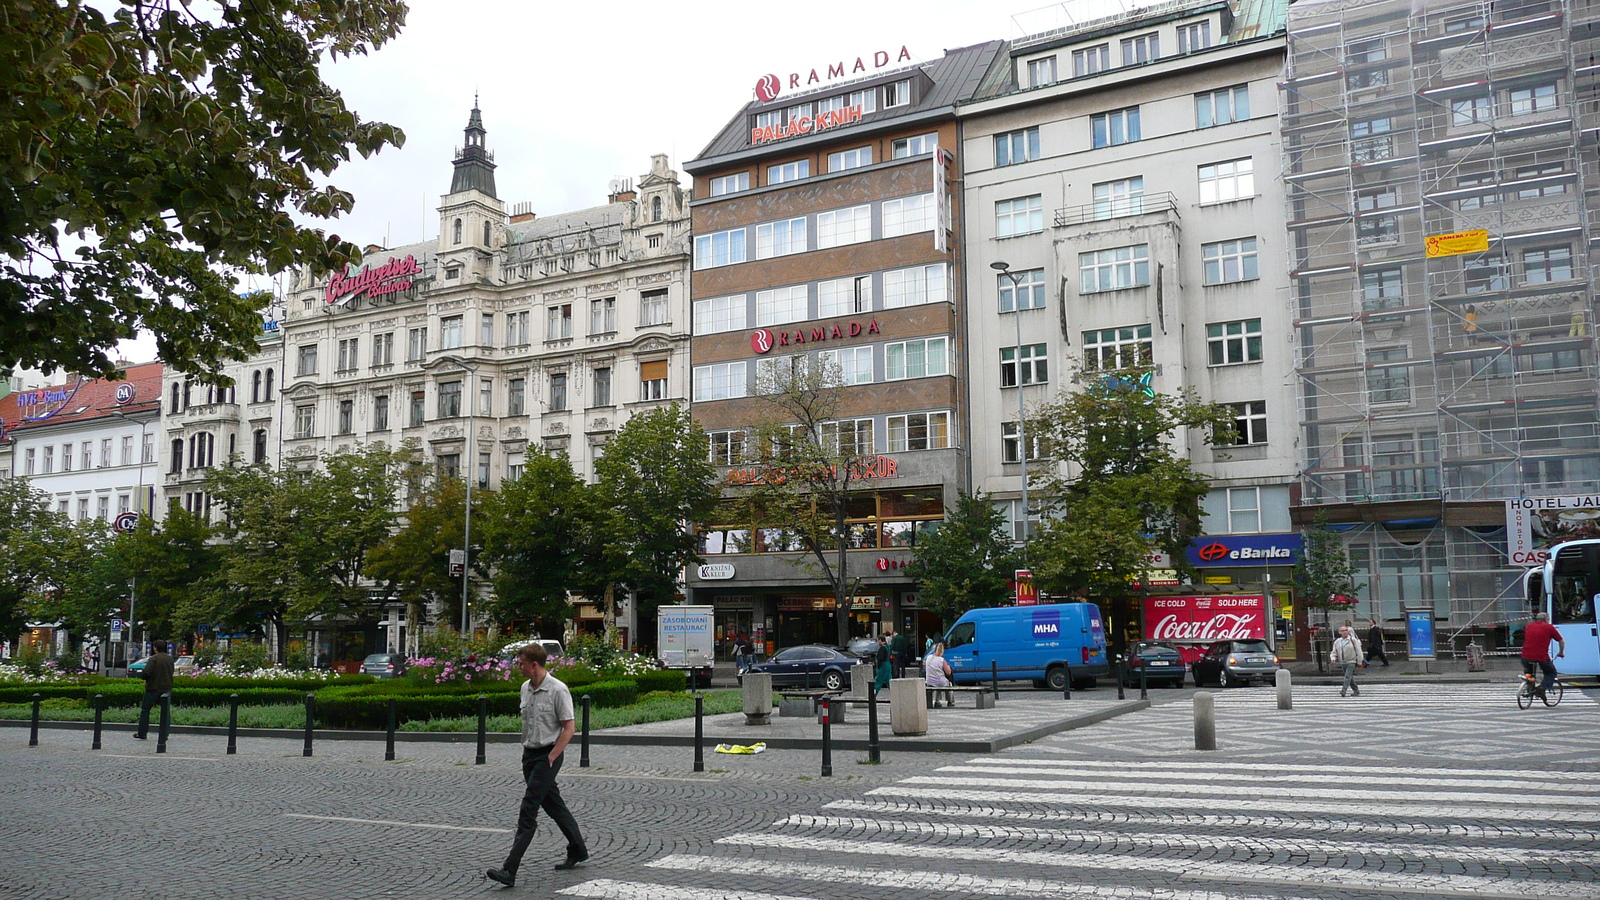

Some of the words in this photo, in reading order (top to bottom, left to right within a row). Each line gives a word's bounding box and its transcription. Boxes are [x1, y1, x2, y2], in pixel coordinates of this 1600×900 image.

[789, 45, 911, 89] RAMADA
[752, 114, 811, 145] PALÁC
[815, 104, 863, 130] KNIH
[326, 254, 422, 304] Budweiser
[367, 279, 413, 298] Budvar
[778, 320, 880, 346] RAMADA
[17, 392, 38, 407] HVB
[44, 387, 67, 402] Bank
[1511, 498, 1567, 509] HOTEL
[113, 620, 120, 628] P
[1034, 623, 1058, 633] MHA
[1153, 613, 1257, 639] Coca-Cola
